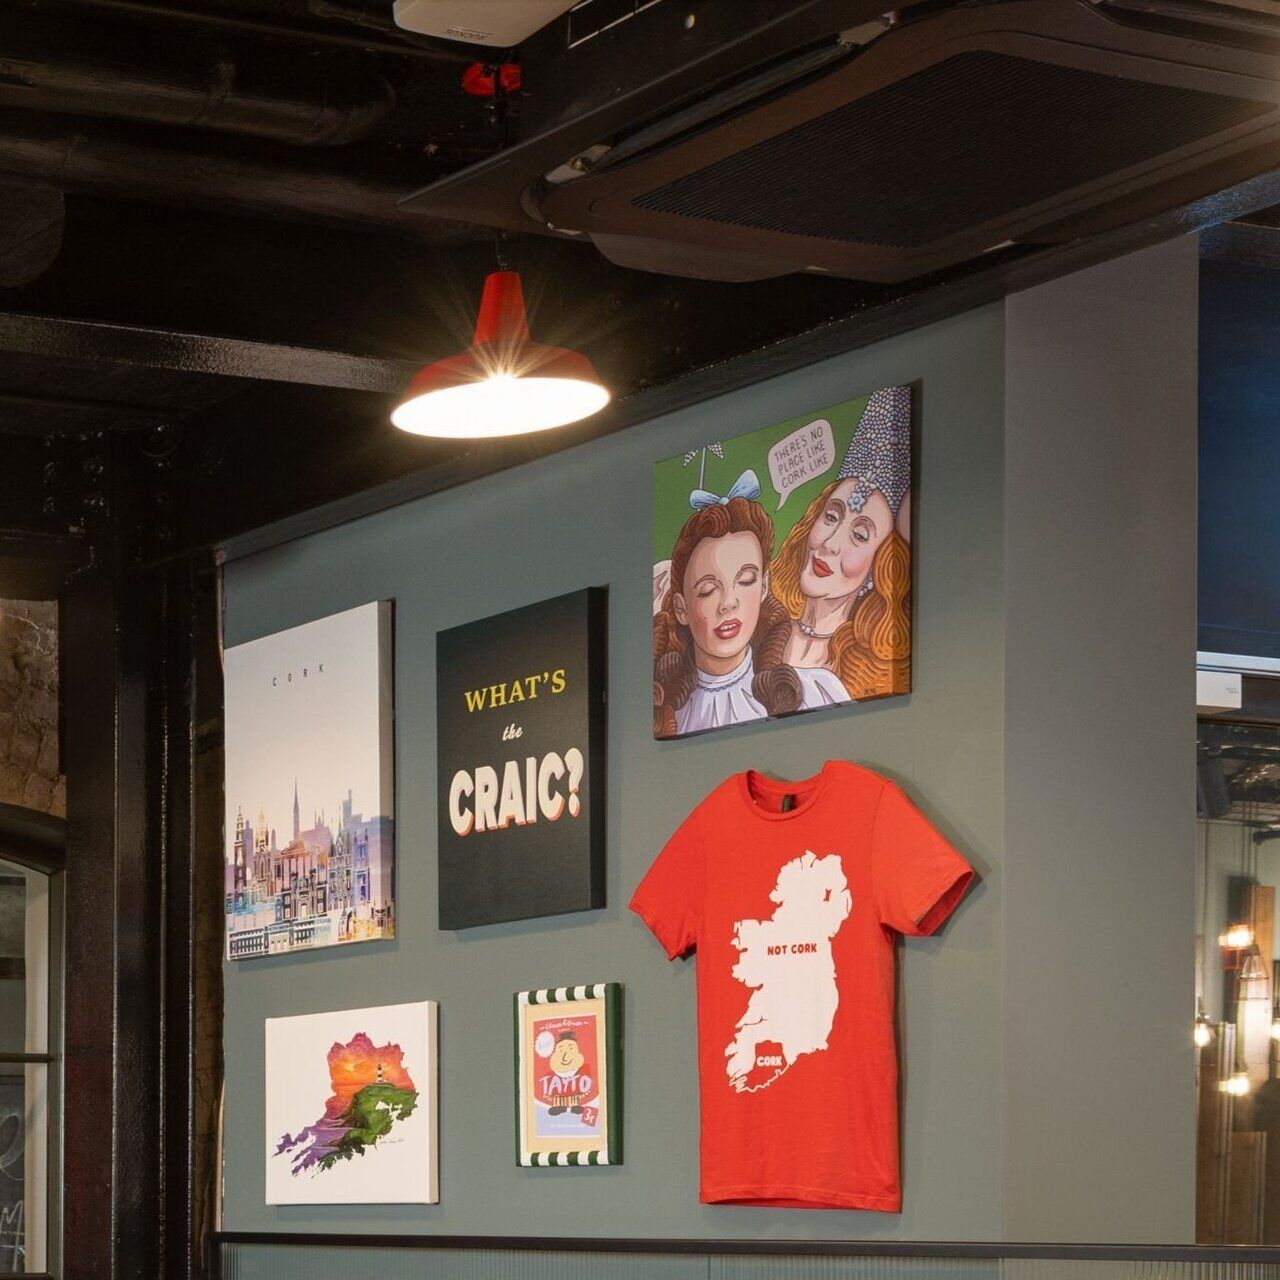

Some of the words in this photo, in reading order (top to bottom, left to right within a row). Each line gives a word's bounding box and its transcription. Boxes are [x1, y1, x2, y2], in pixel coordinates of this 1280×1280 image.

[810, 426, 823, 442] NO
[777, 452, 805, 476] PLACE
[806, 439, 826, 458] LIKE
[781, 465, 808, 488] CORK
[808, 453, 829, 472] LIKE
[272, 663, 324, 687] CORK
[464, 669, 566, 713] WHAT'S
[502, 723, 524, 741] the
[448, 747, 585, 837] CRAIC?
[767, 945, 788, 956] NOT
[791, 943, 817, 954] CORK
[756, 1055, 783, 1067] CORK
